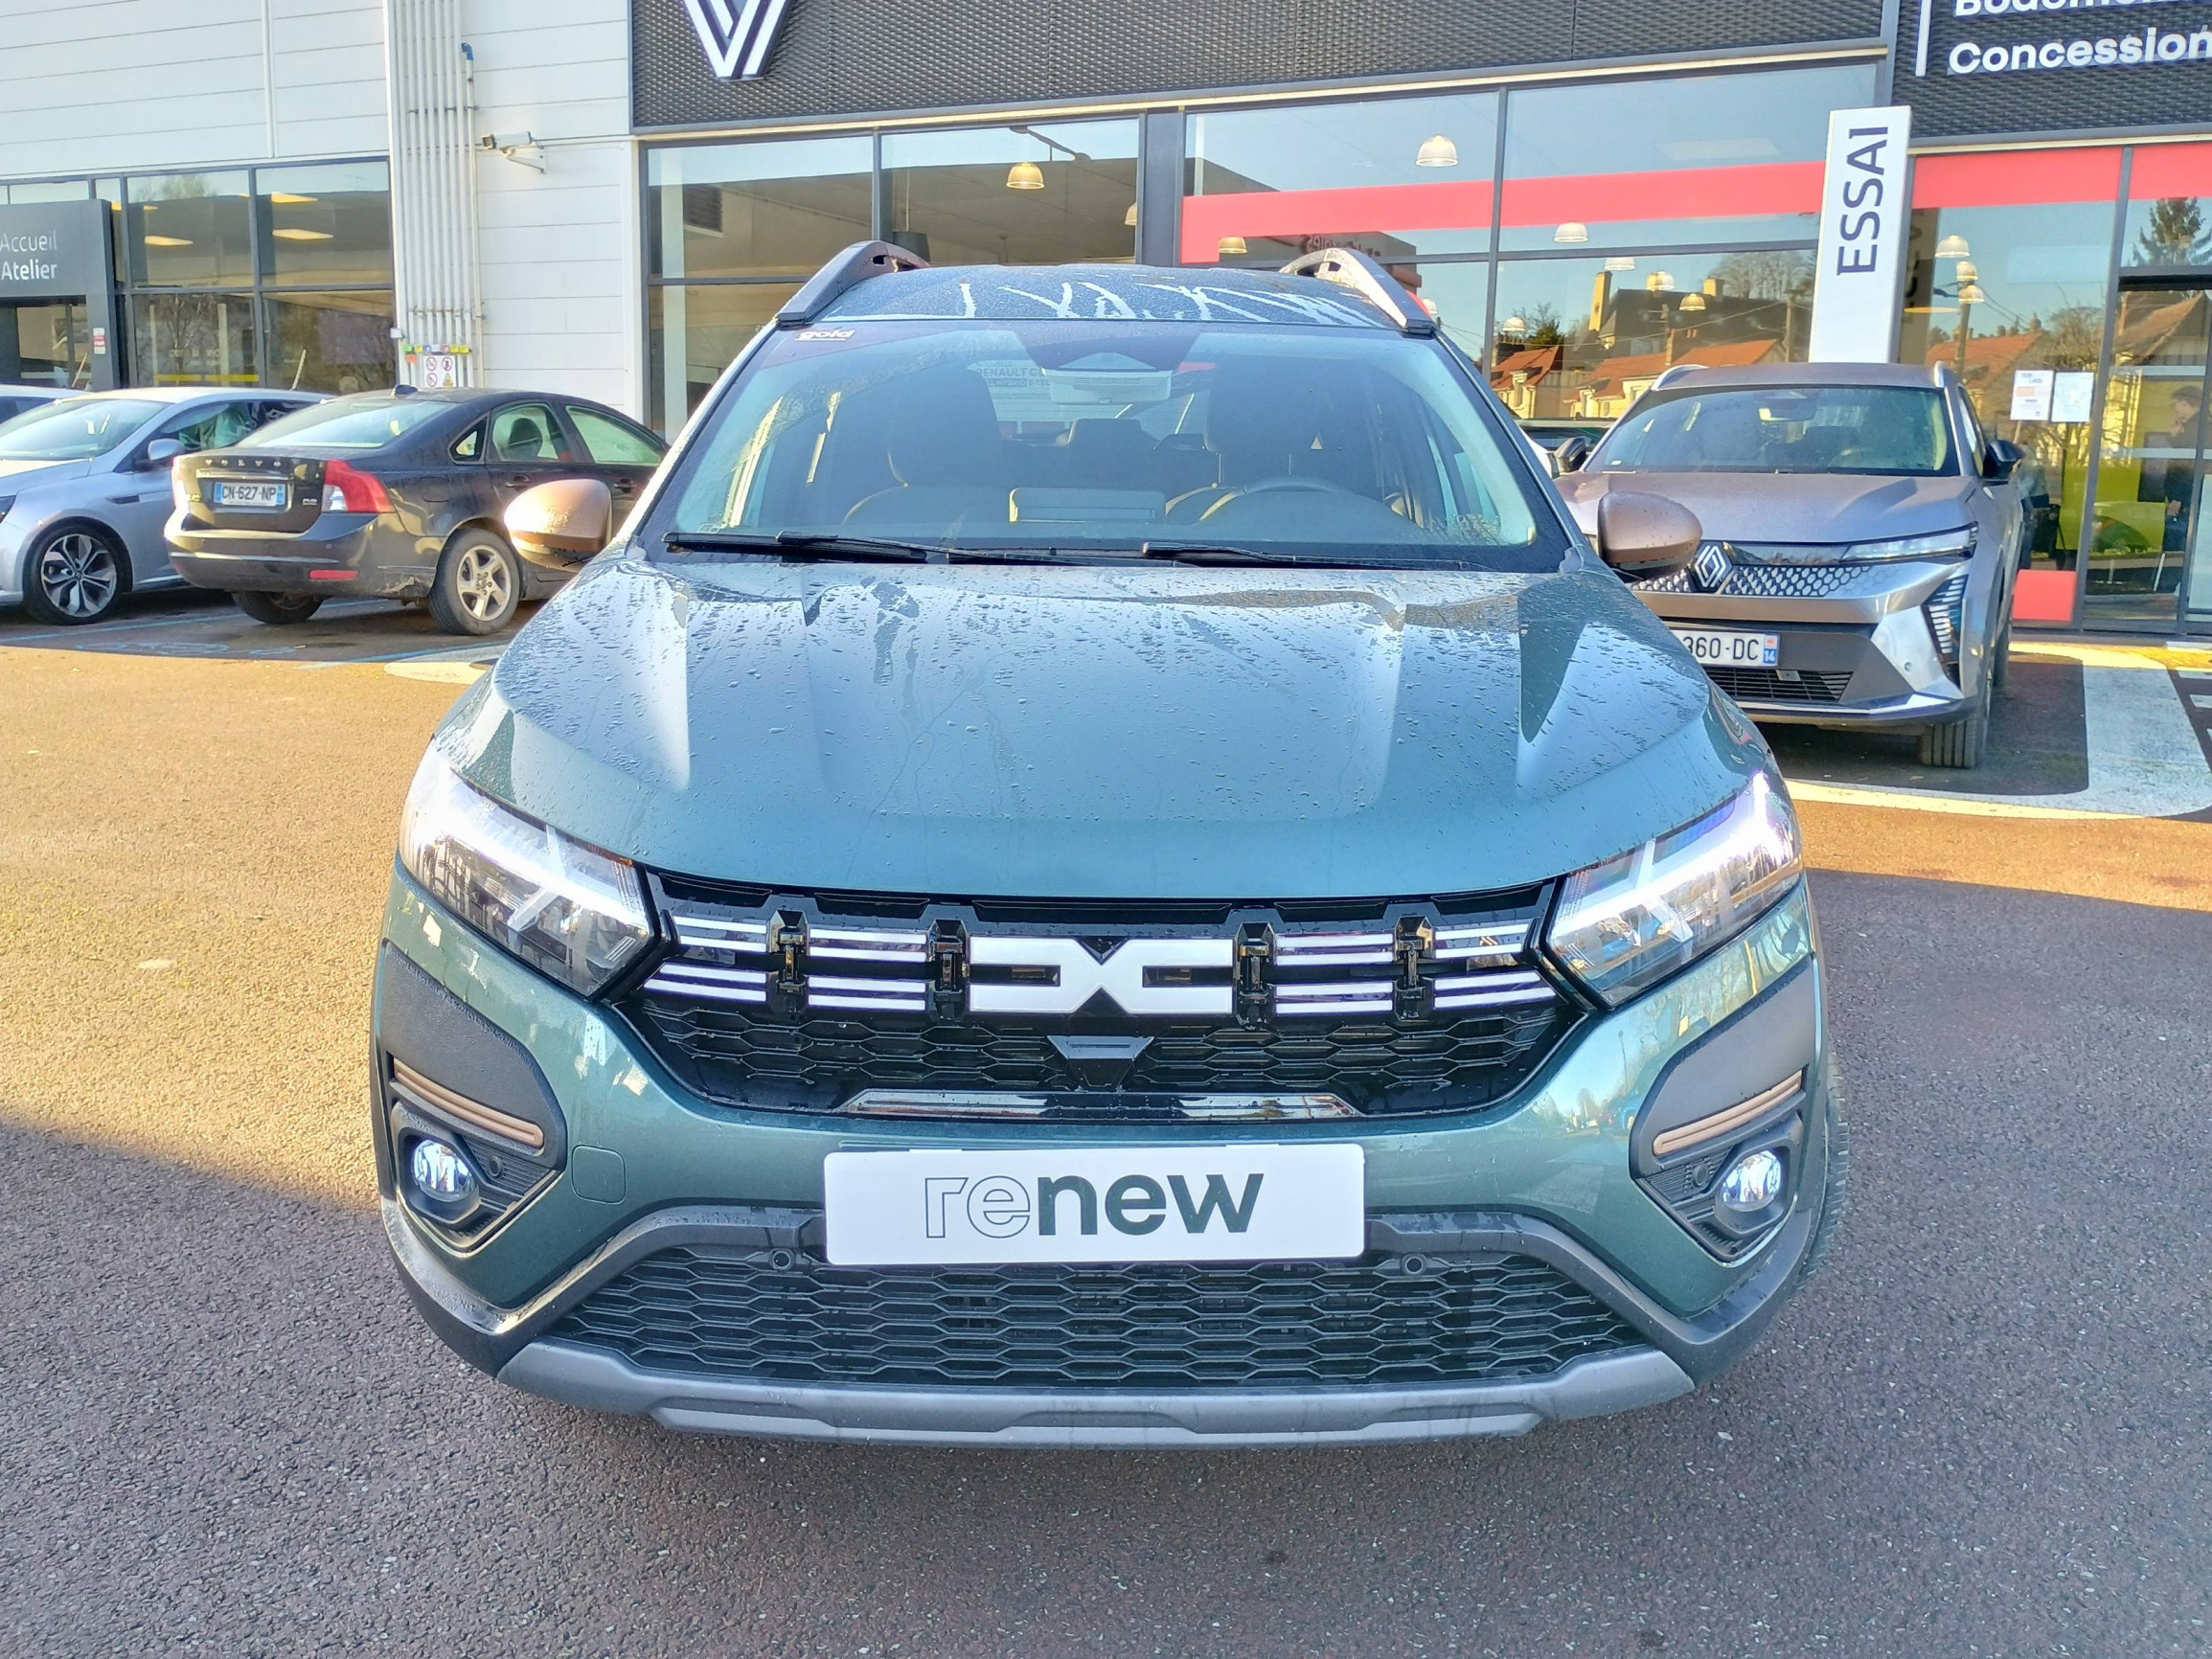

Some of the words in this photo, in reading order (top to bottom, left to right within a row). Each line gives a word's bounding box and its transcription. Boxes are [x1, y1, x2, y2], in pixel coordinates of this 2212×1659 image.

[1949, 27, 2212, 74] Concession
[1836, 126, 1889, 277] ESSAI
[0, 229, 57, 253] Accueil
[1, 259, 57, 281] Atelier
[798, 329, 856, 340] gold
[221, 486, 277, 501] CN-627-NP
[924, 1172, 1265, 1239] renew
